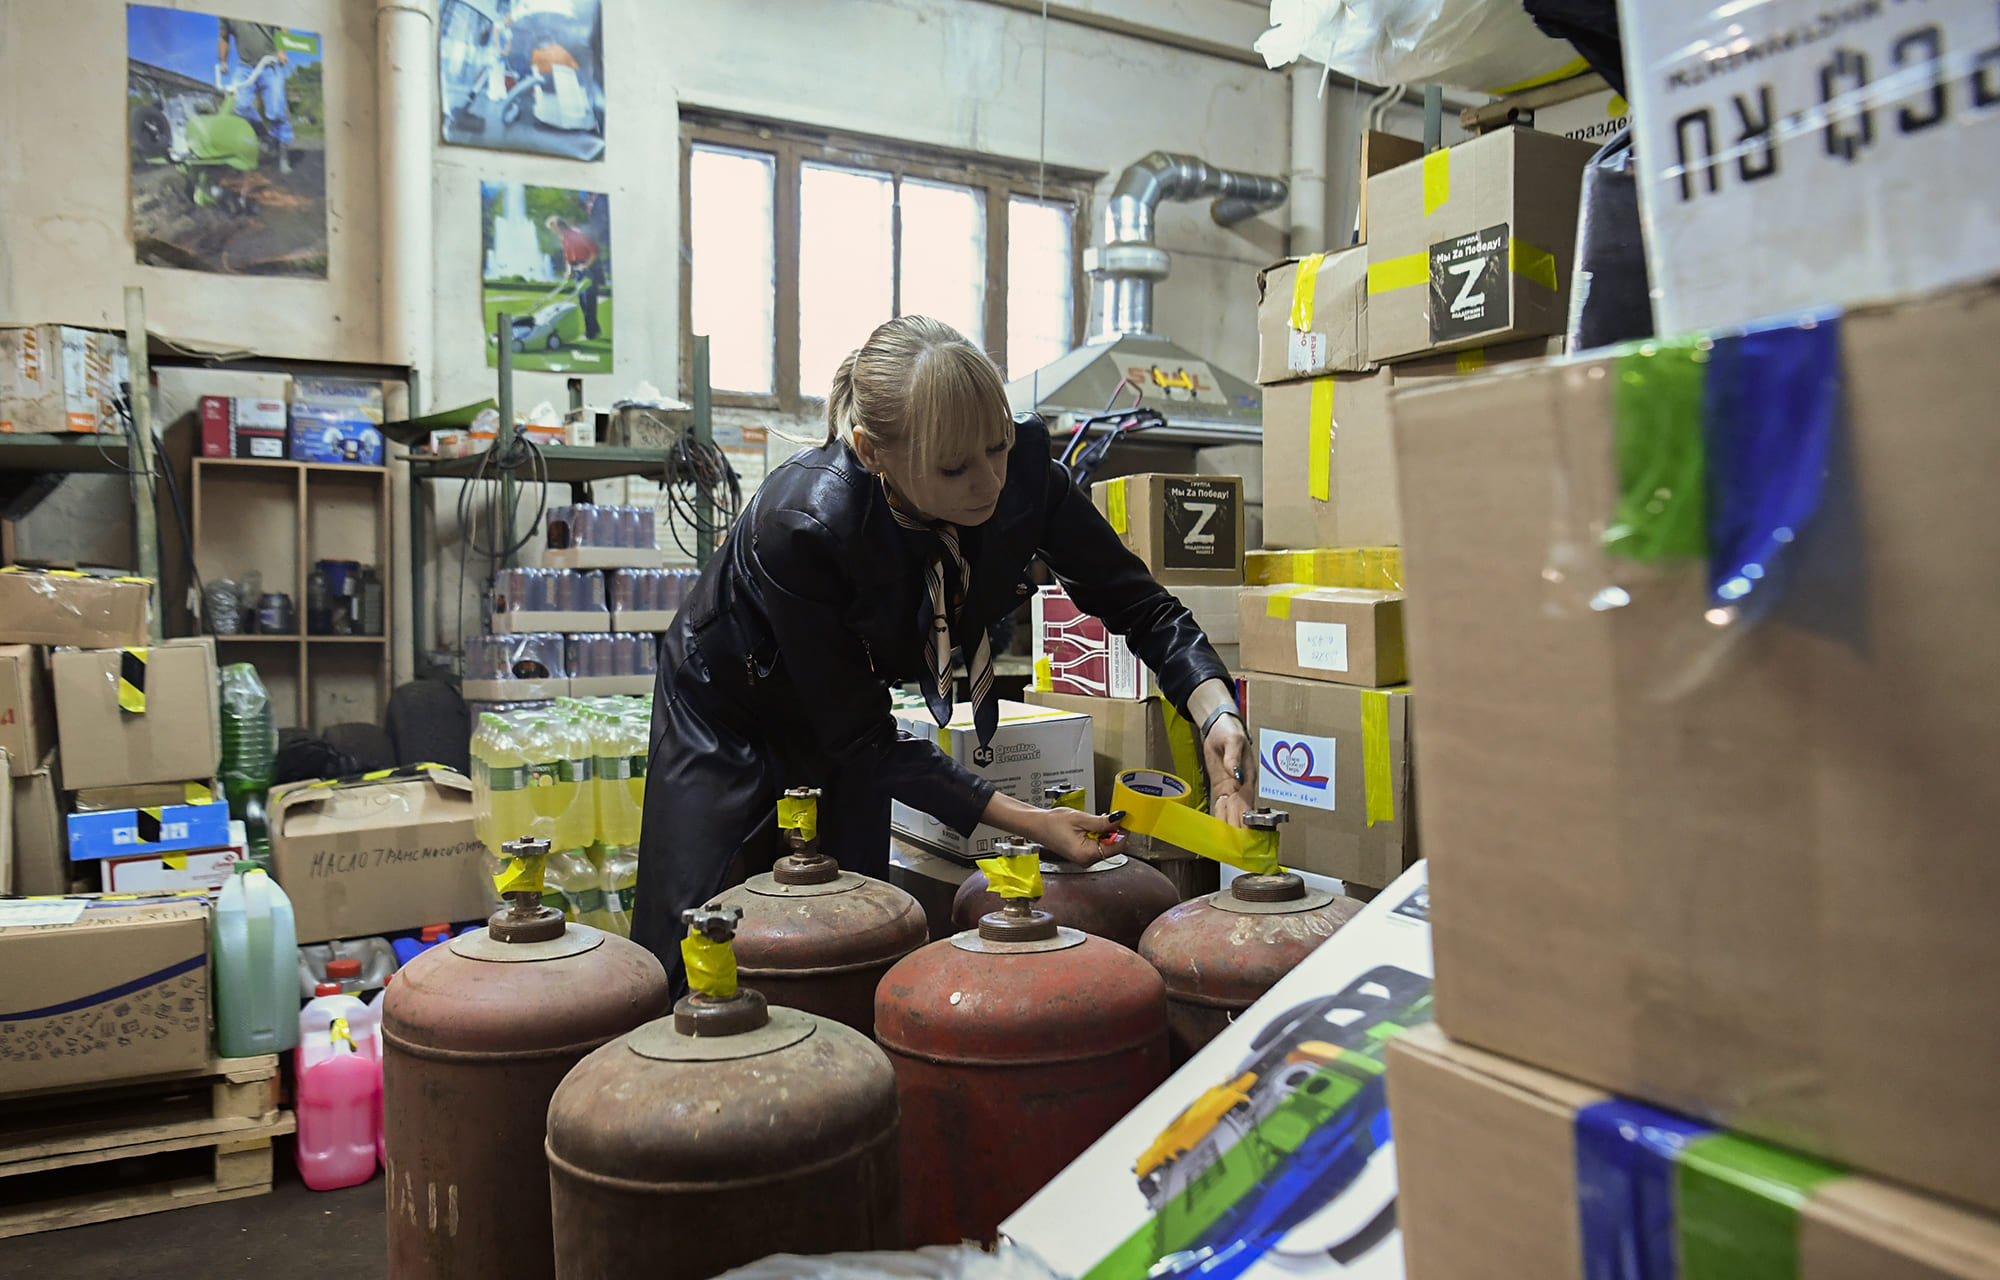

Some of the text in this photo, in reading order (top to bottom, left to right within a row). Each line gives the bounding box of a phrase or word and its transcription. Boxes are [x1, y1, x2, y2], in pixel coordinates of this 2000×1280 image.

[1565, 116, 1632, 141] разде
[1436, 252, 1451, 263] Мы
[1465, 236, 1502, 256] Победу!
[1448, 256, 1487, 313] Z
[1171, 487, 1230, 500] Мы Za Победу!
[1183, 502, 1217, 544] Z
[310, 850, 369, 879] МАСЛО
